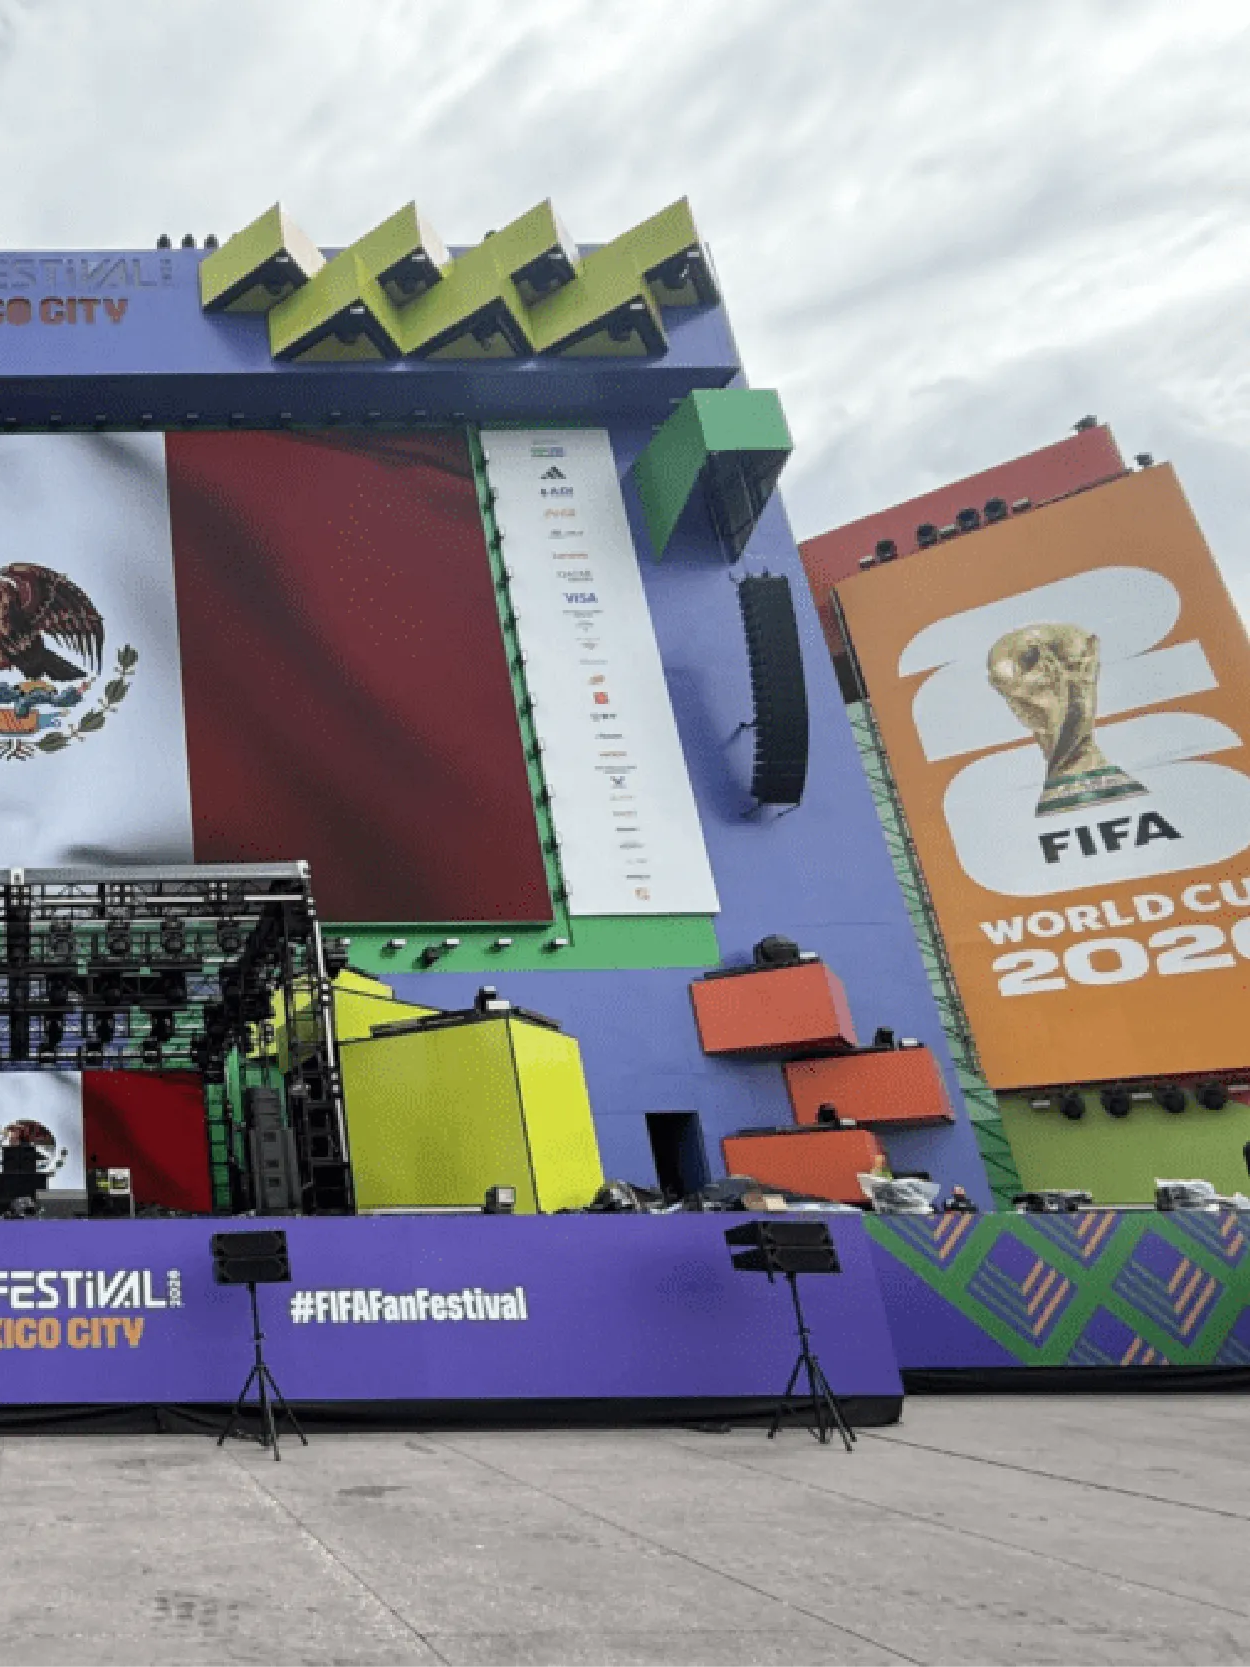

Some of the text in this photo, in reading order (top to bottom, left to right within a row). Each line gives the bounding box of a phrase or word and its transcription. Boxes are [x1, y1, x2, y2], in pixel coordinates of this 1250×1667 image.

[40, 298, 128, 325] CITY
[1038, 811, 1184, 863] FIFA
[980, 877, 1250, 945] WORLD CU
[992, 917, 1250, 997] 202
[290, 1287, 528, 1323] #FIFAFanFestival
[67, 1317, 145, 1349] CITY
